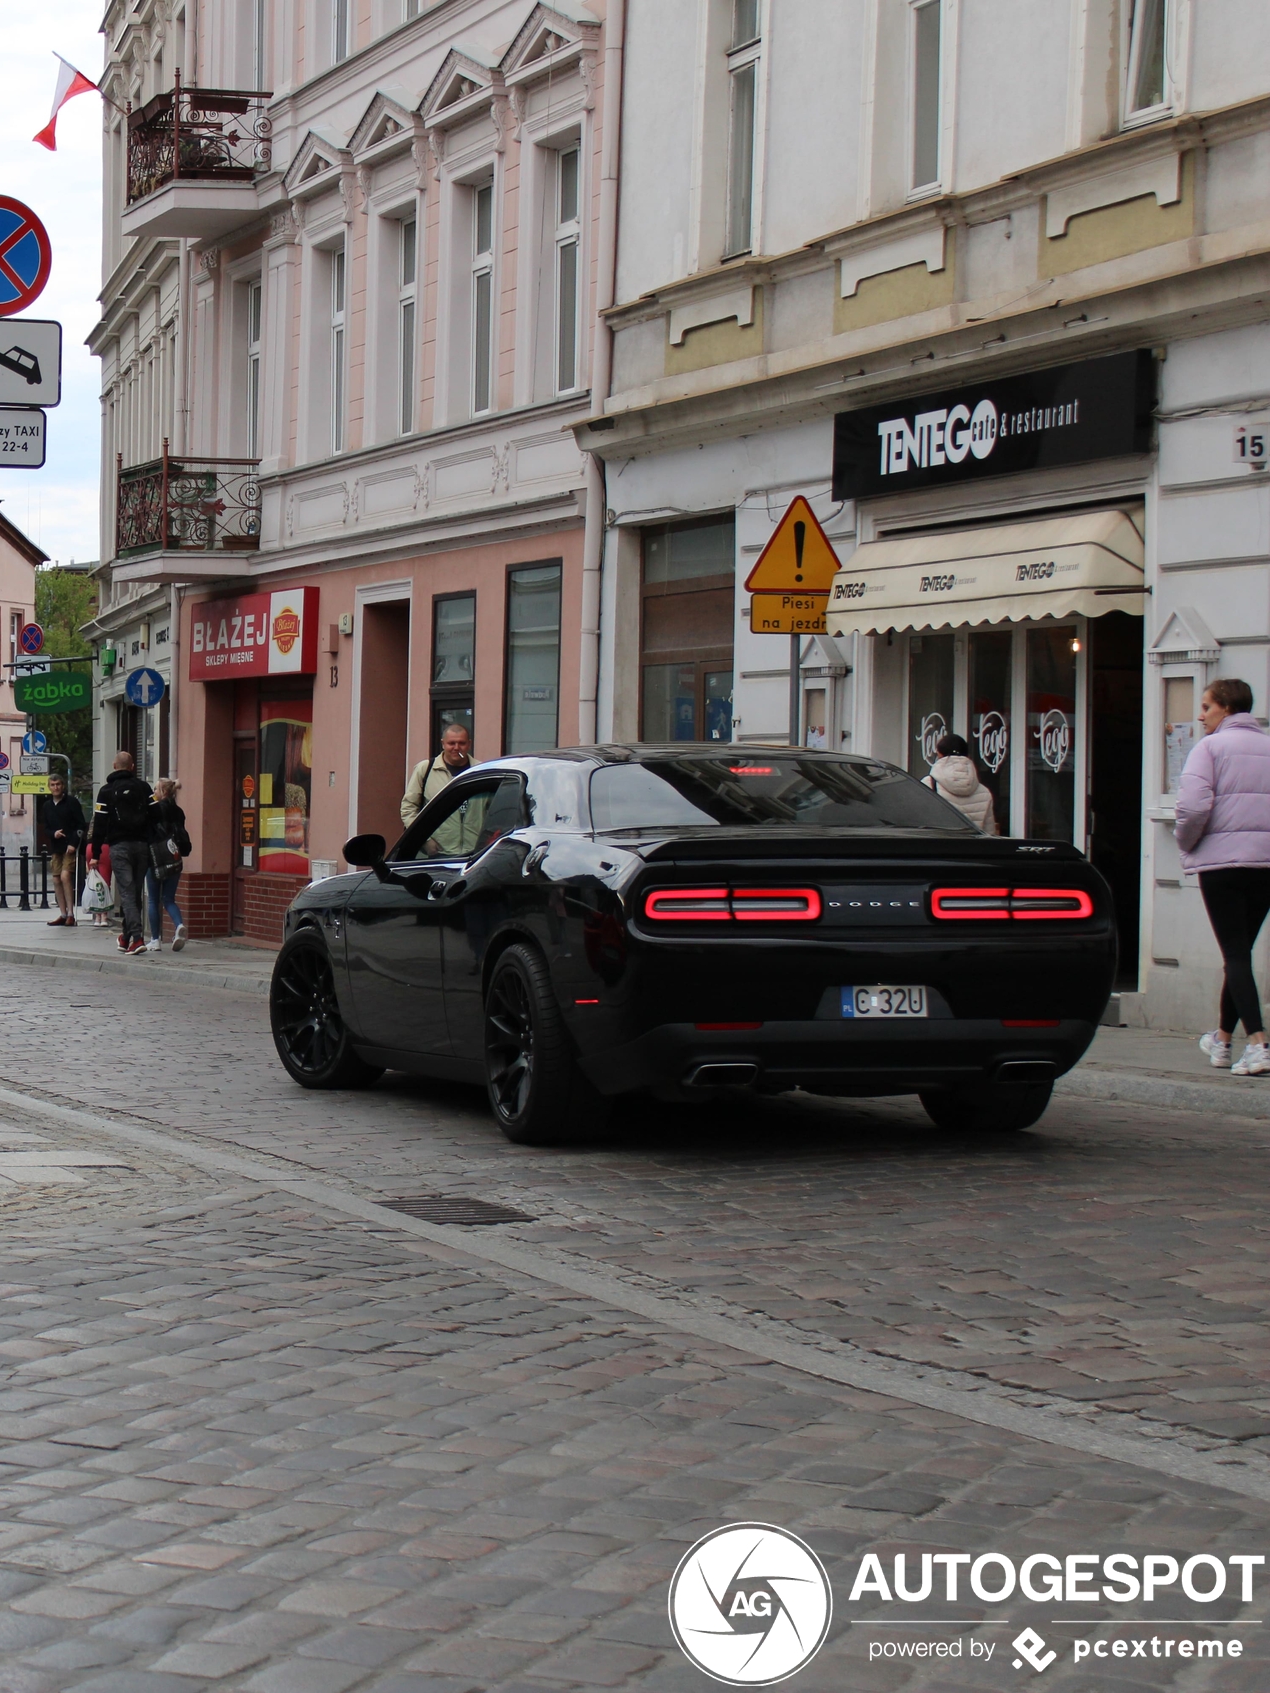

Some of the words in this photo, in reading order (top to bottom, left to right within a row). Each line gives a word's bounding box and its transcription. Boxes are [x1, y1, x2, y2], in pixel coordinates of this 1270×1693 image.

[14, 425, 39, 437] TAXI
[877, 399, 998, 476] TENTEGO
[971, 414, 996, 442] cafe
[999, 412, 1009, 438] &
[1011, 398, 1079, 436] restaurant
[2, 441, 29, 452] 22-4
[1235, 435, 1264, 457] 15
[1015, 561, 1055, 582] TENTEGO
[833, 582, 866, 599] TENTEGO
[919, 574, 955, 592] TENTEGO
[782, 596, 815, 609] Piesi
[193, 608, 267, 653] BŁAŻEJ
[762, 619, 780, 628] na
[205, 655, 229, 667] SKLEPY
[230, 651, 254, 665] MIĘSNE
[330, 665, 338, 688] 13
[23, 682, 84, 701] żabka
[1016, 846, 1055, 854] SRT
[843, 1004, 853, 1013] PL
[854, 988, 870, 1014] C
[879, 988, 923, 1014] 32U
